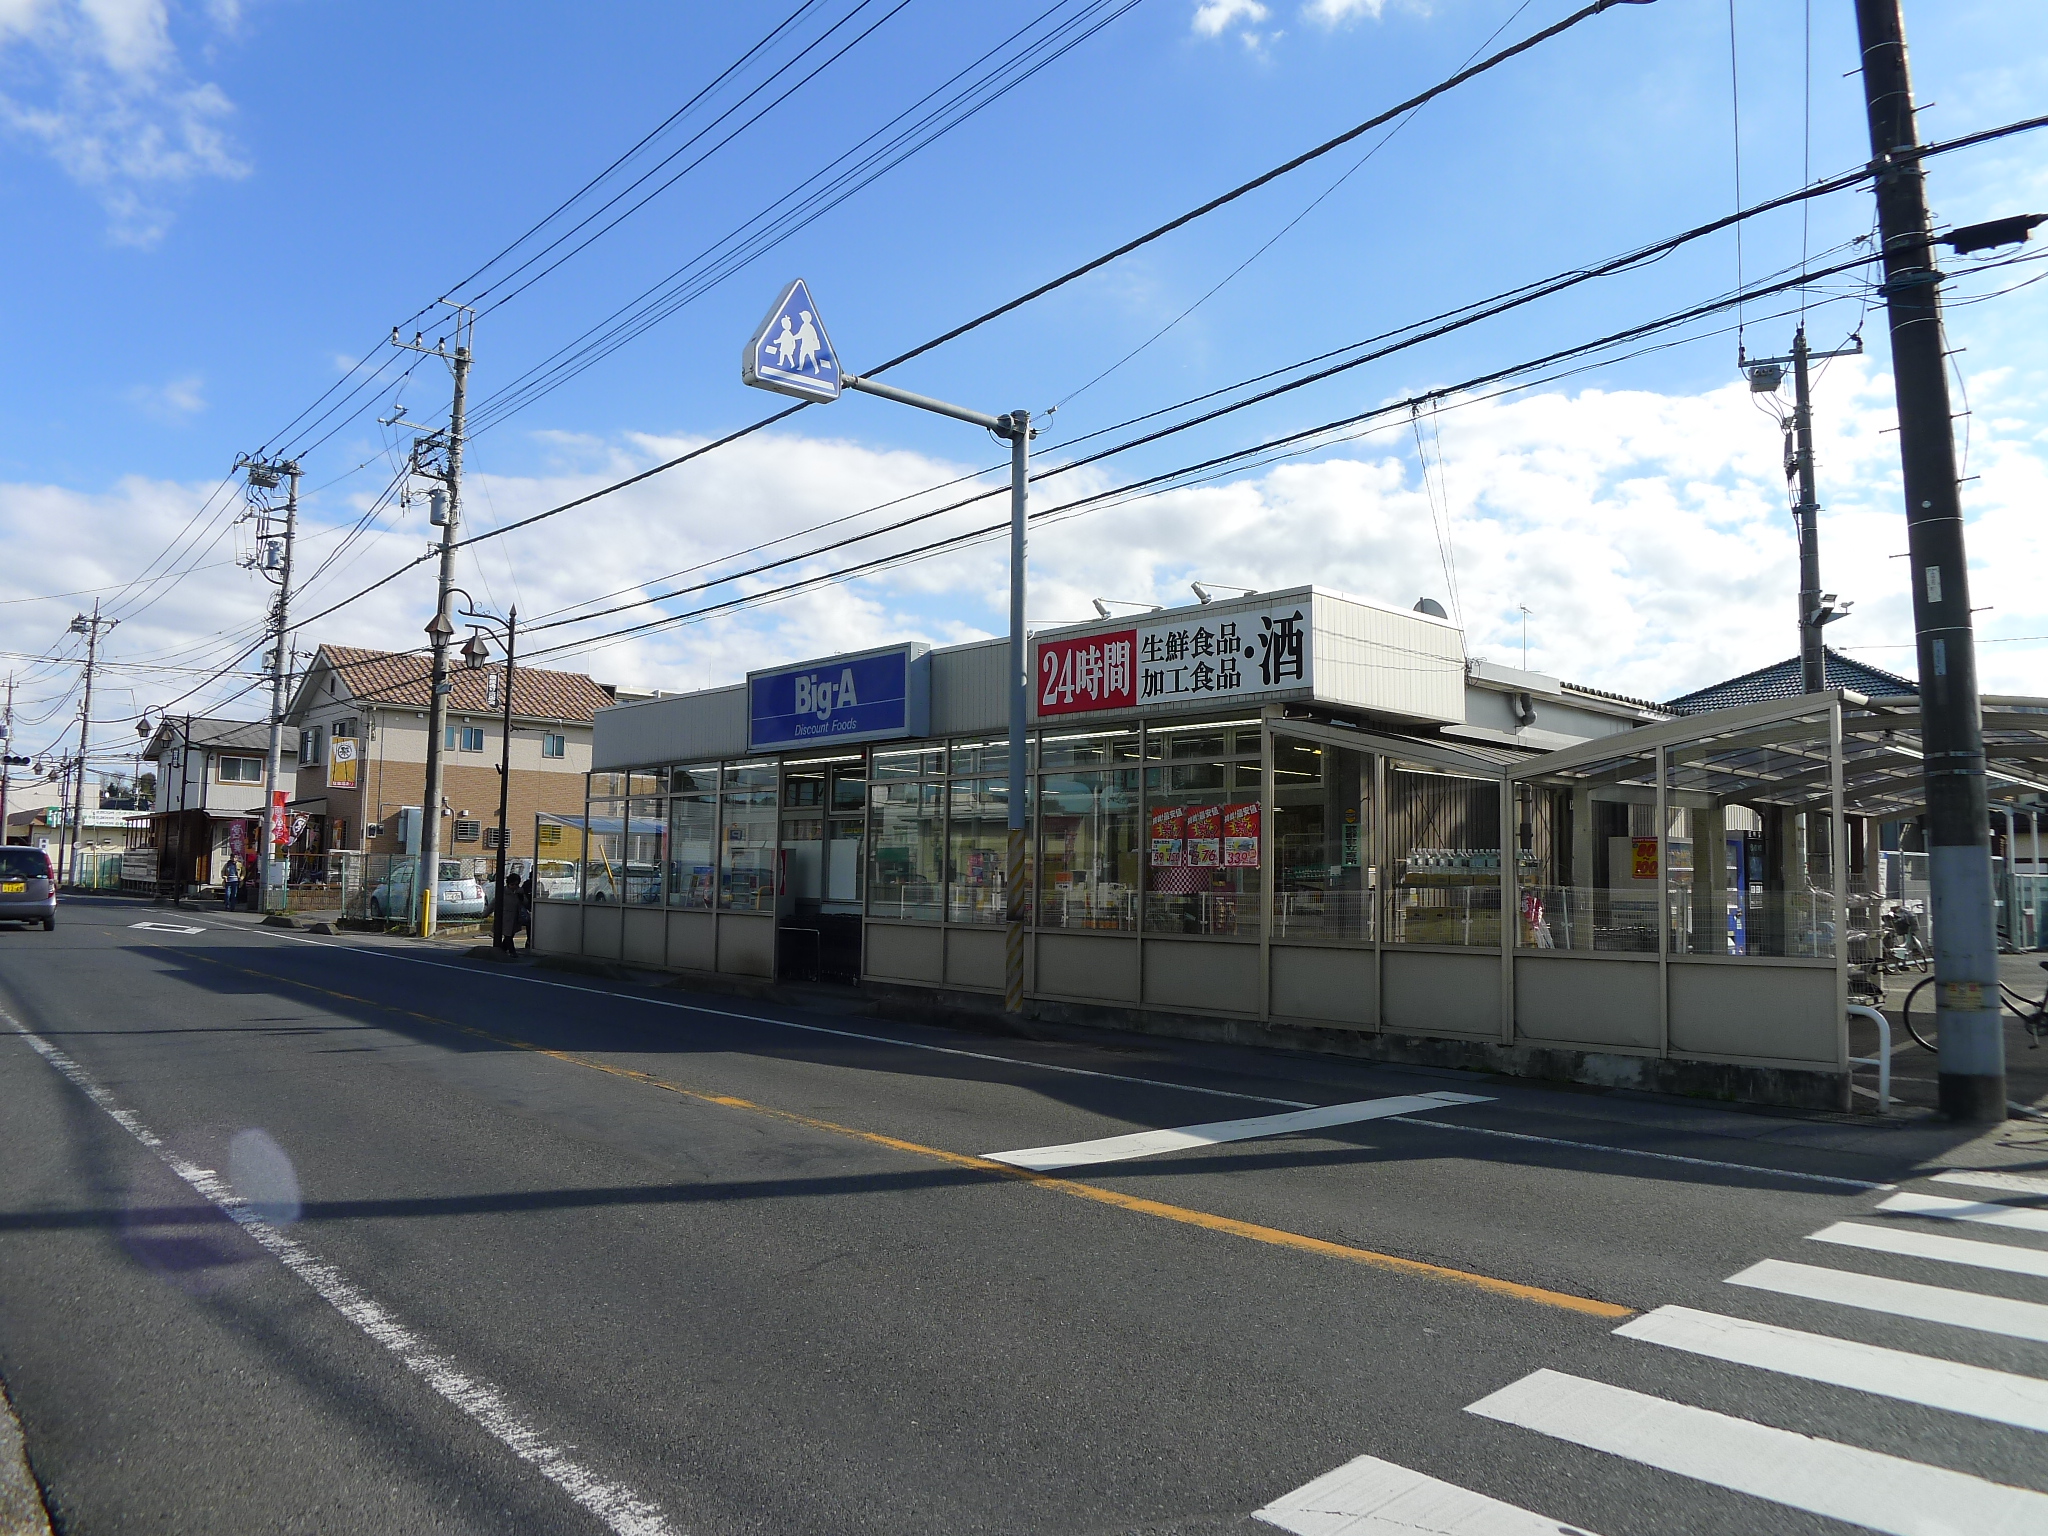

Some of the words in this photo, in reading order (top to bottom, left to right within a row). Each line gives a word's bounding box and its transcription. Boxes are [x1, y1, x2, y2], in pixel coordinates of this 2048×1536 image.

[1141, 621, 1241, 663] 生鮮食品
[1042, 639, 1132, 705] 24時間
[1141, 657, 1242, 699] 加工食品
[795, 721, 829, 736] Discount
[831, 717, 857, 731] Foods
